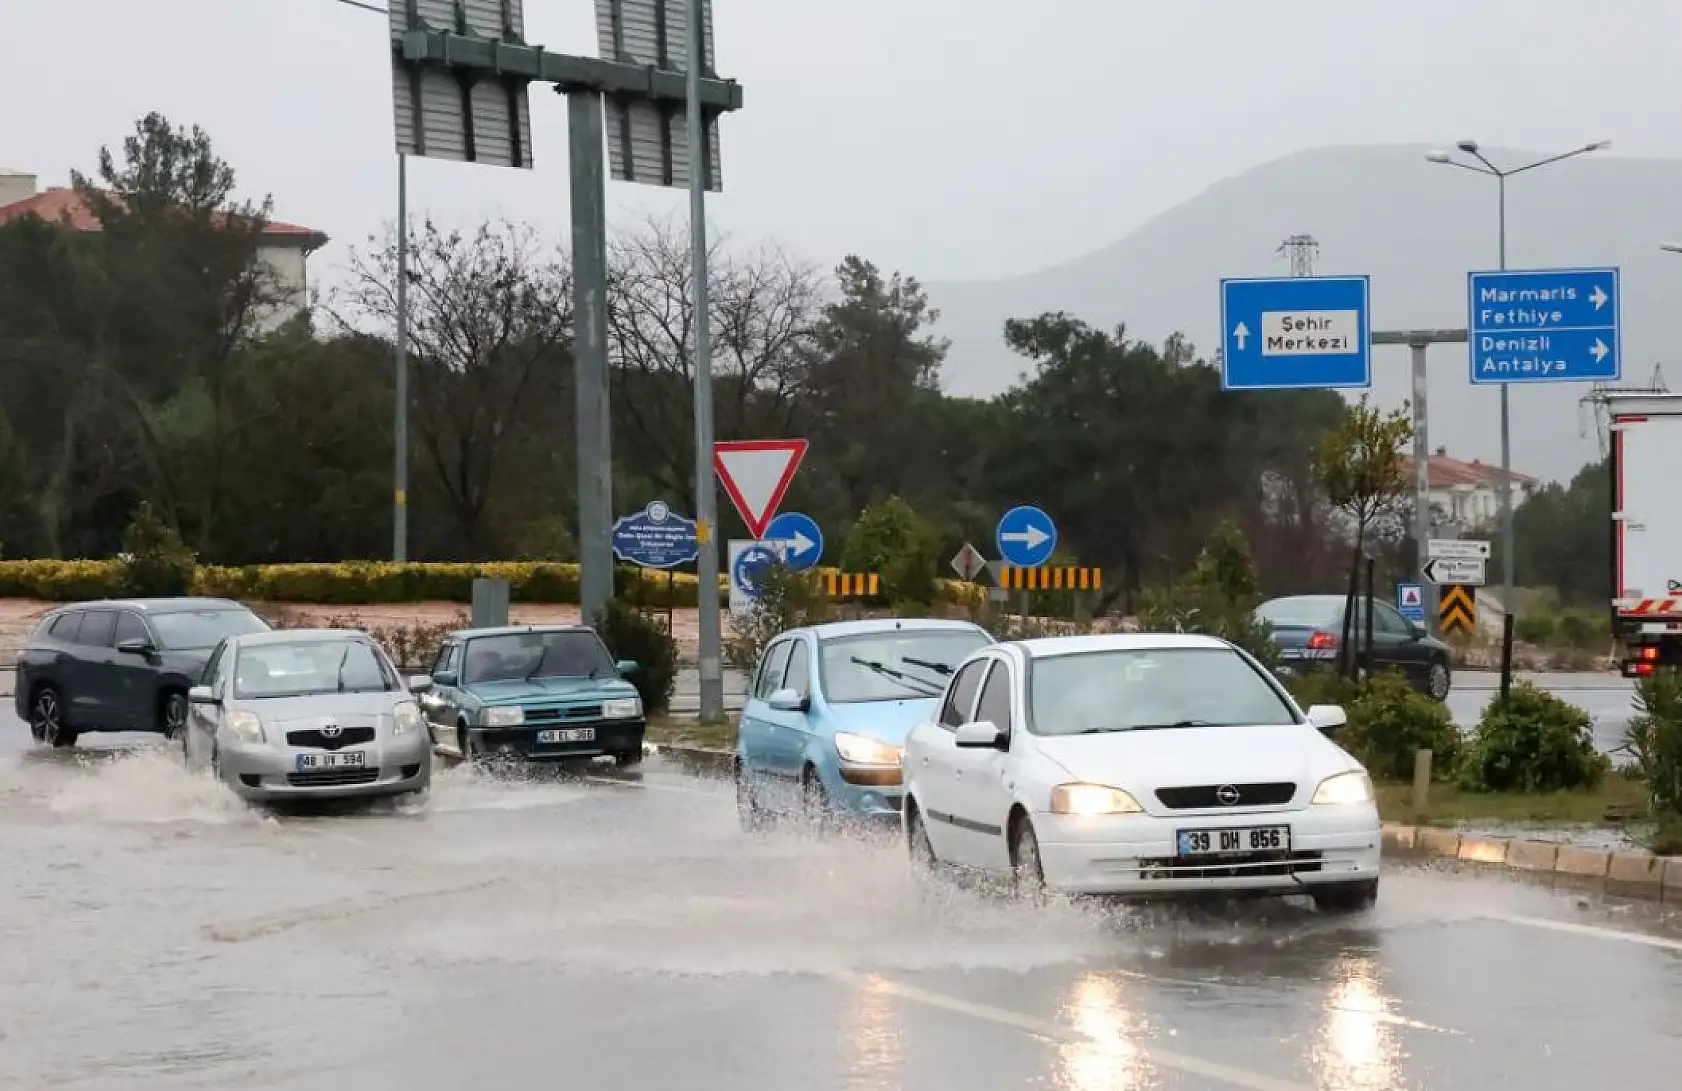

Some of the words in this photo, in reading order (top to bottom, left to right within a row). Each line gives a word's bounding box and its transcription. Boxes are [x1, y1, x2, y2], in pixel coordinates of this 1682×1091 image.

[1481, 287, 1577, 302] Marmaris
[1282, 316, 1333, 332] Şehir
[1481, 309, 1562, 326] Fethiye
[1267, 336, 1348, 350] Merkezi
[1482, 336, 1549, 351] Denizli
[1483, 357, 1567, 374] Antalya
[1190, 832, 1210, 850] 39
[1220, 830, 1239, 849] DH
[1250, 828, 1281, 848] 856
